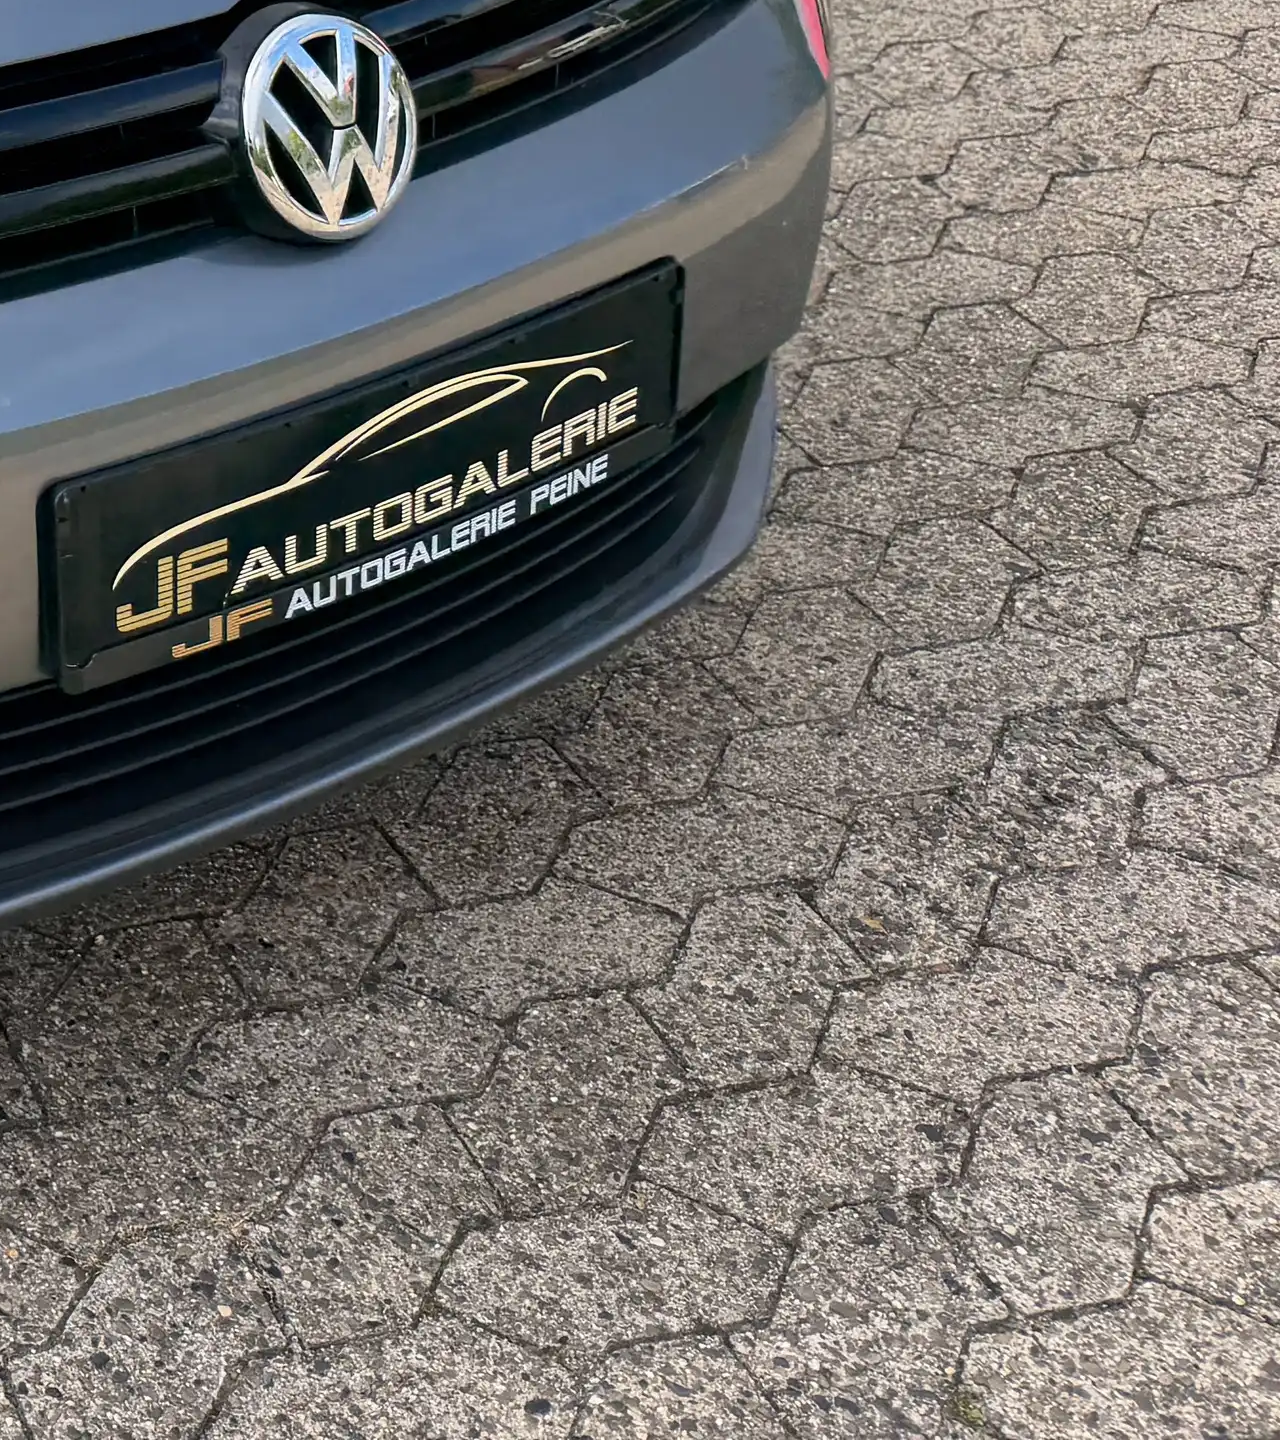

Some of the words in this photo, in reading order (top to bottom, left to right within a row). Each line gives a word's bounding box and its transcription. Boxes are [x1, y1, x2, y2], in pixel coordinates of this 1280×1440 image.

[116, 538, 228, 633] JF
[231, 387, 639, 596] AUTOGALERIE
[171, 598, 273, 658] JF
[284, 498, 517, 619] AUTOGALERIE
[530, 453, 609, 516] PEINE
